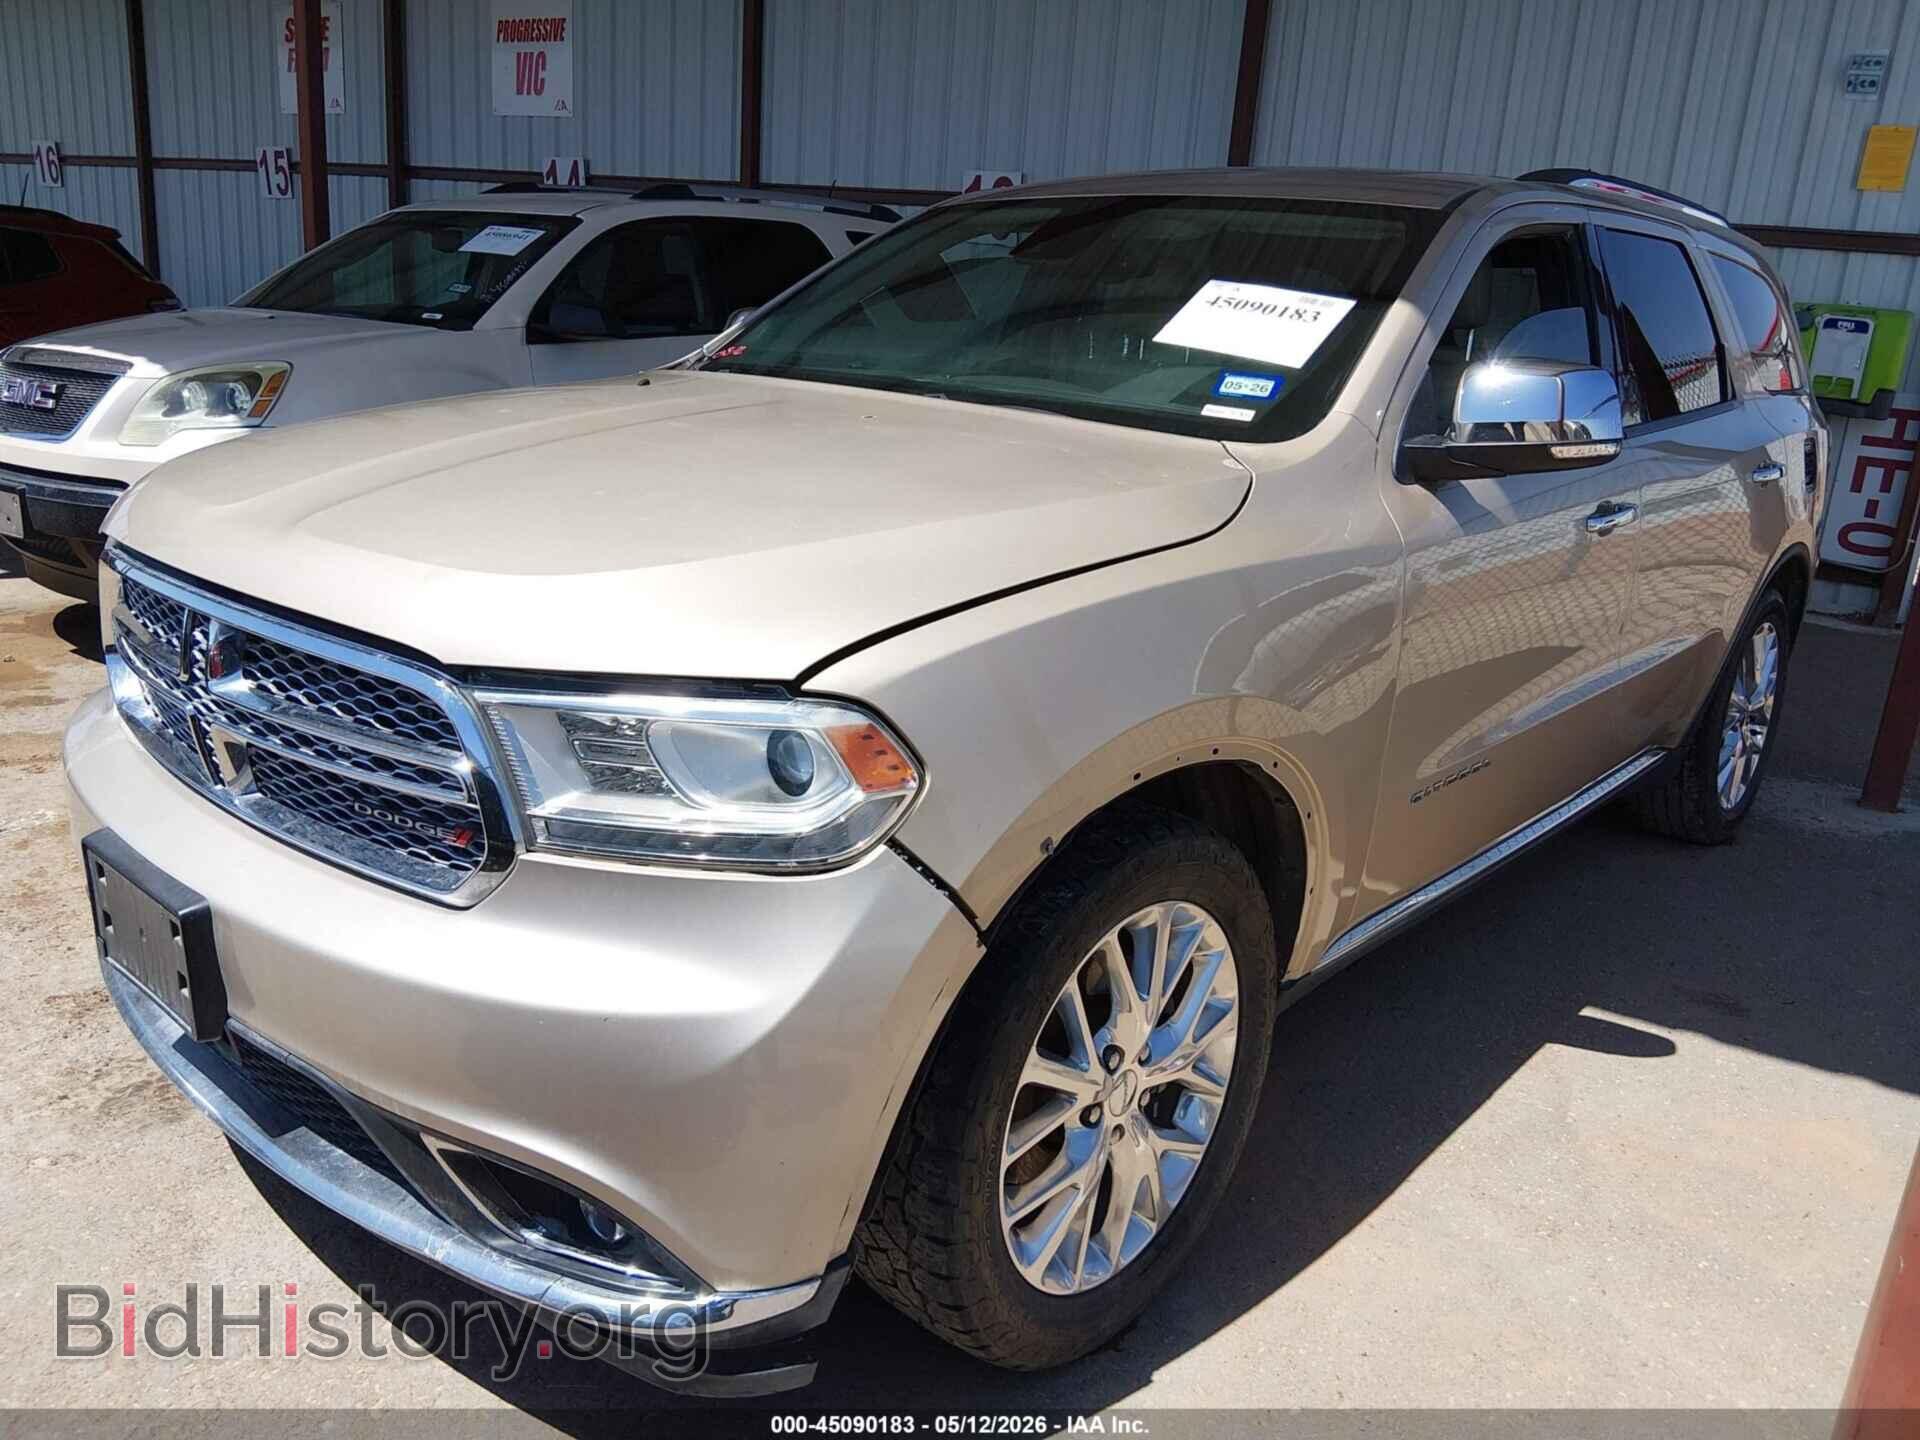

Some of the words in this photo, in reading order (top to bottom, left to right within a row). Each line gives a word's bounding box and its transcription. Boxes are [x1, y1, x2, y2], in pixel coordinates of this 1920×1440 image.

[496, 17, 567, 43] PROGRESSIVE
[516, 51, 546, 96] VIC
[36, 144, 60, 184] 16
[259, 149, 289, 196] 15
[1205, 295, 1321, 323] 45090183
[1, 379, 57, 409] GMC
[353, 801, 458, 840] DODGE
